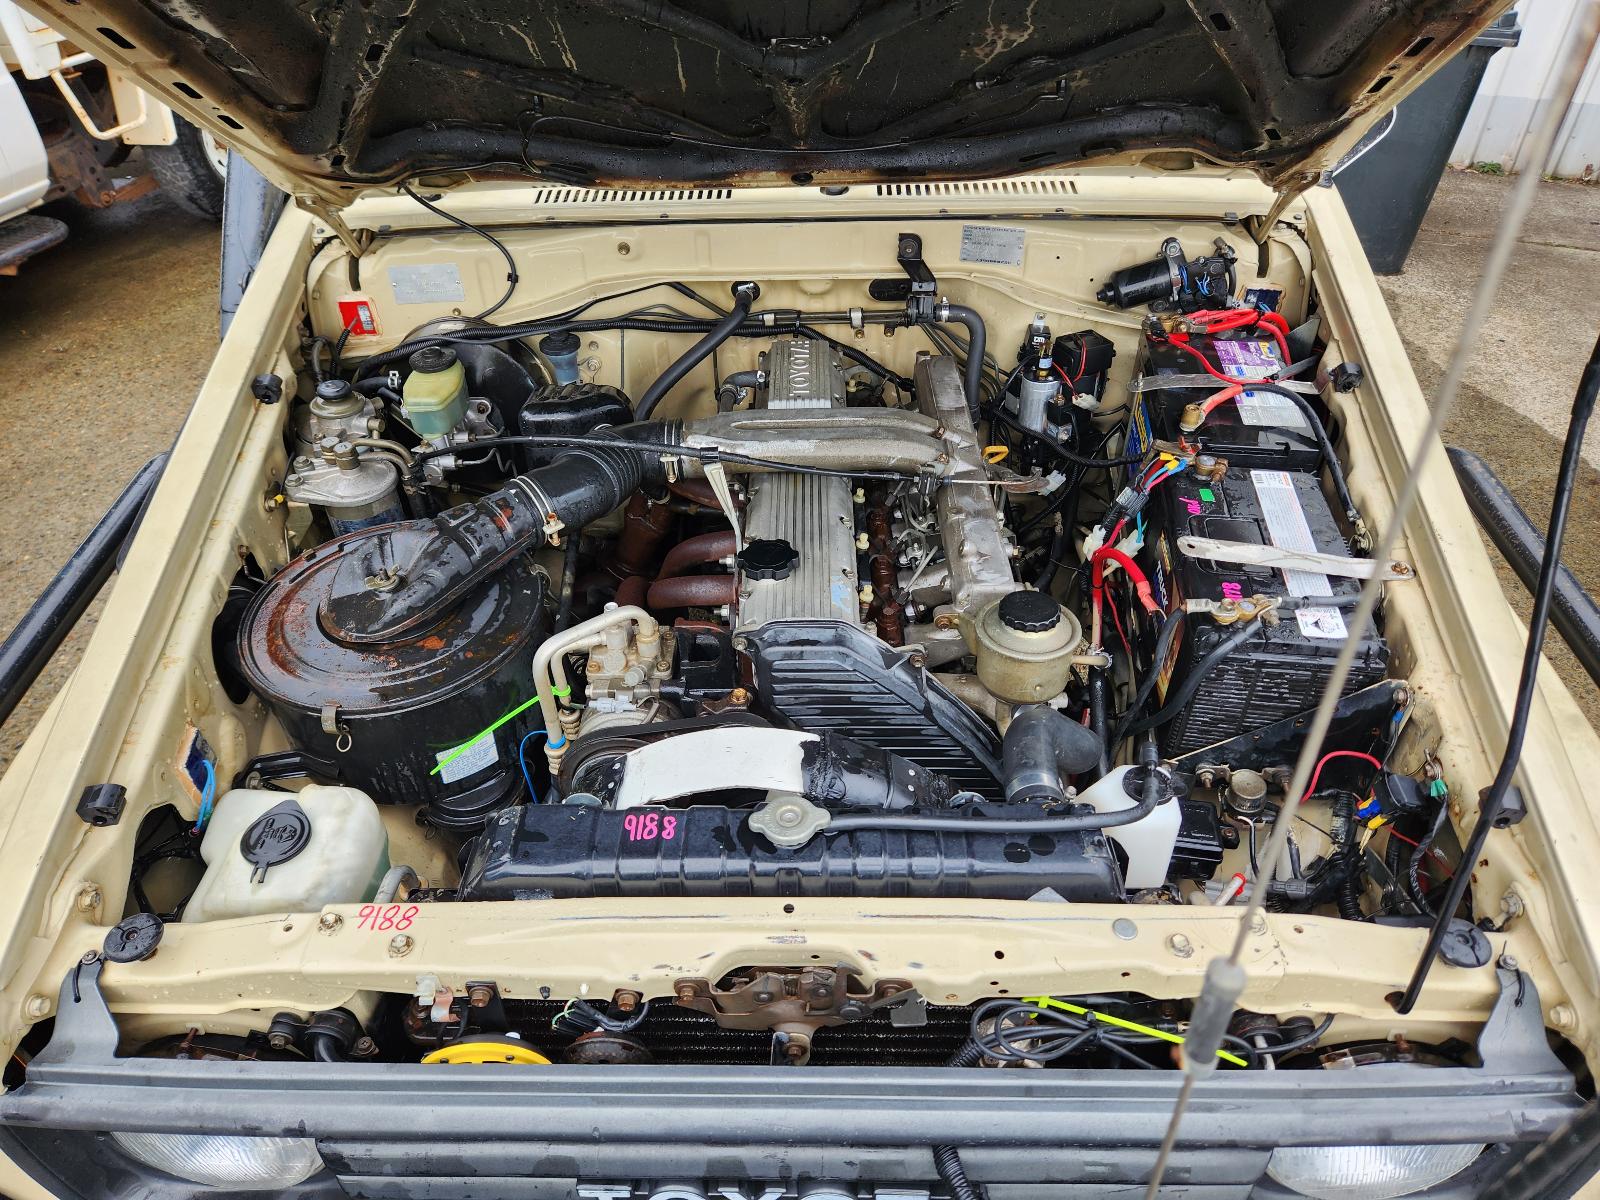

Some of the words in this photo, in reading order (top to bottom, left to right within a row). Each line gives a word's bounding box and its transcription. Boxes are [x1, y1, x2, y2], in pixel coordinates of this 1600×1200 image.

[789, 343, 810, 396] TOYOTA
[624, 813, 677, 841] 9188
[357, 904, 419, 931] 9188
